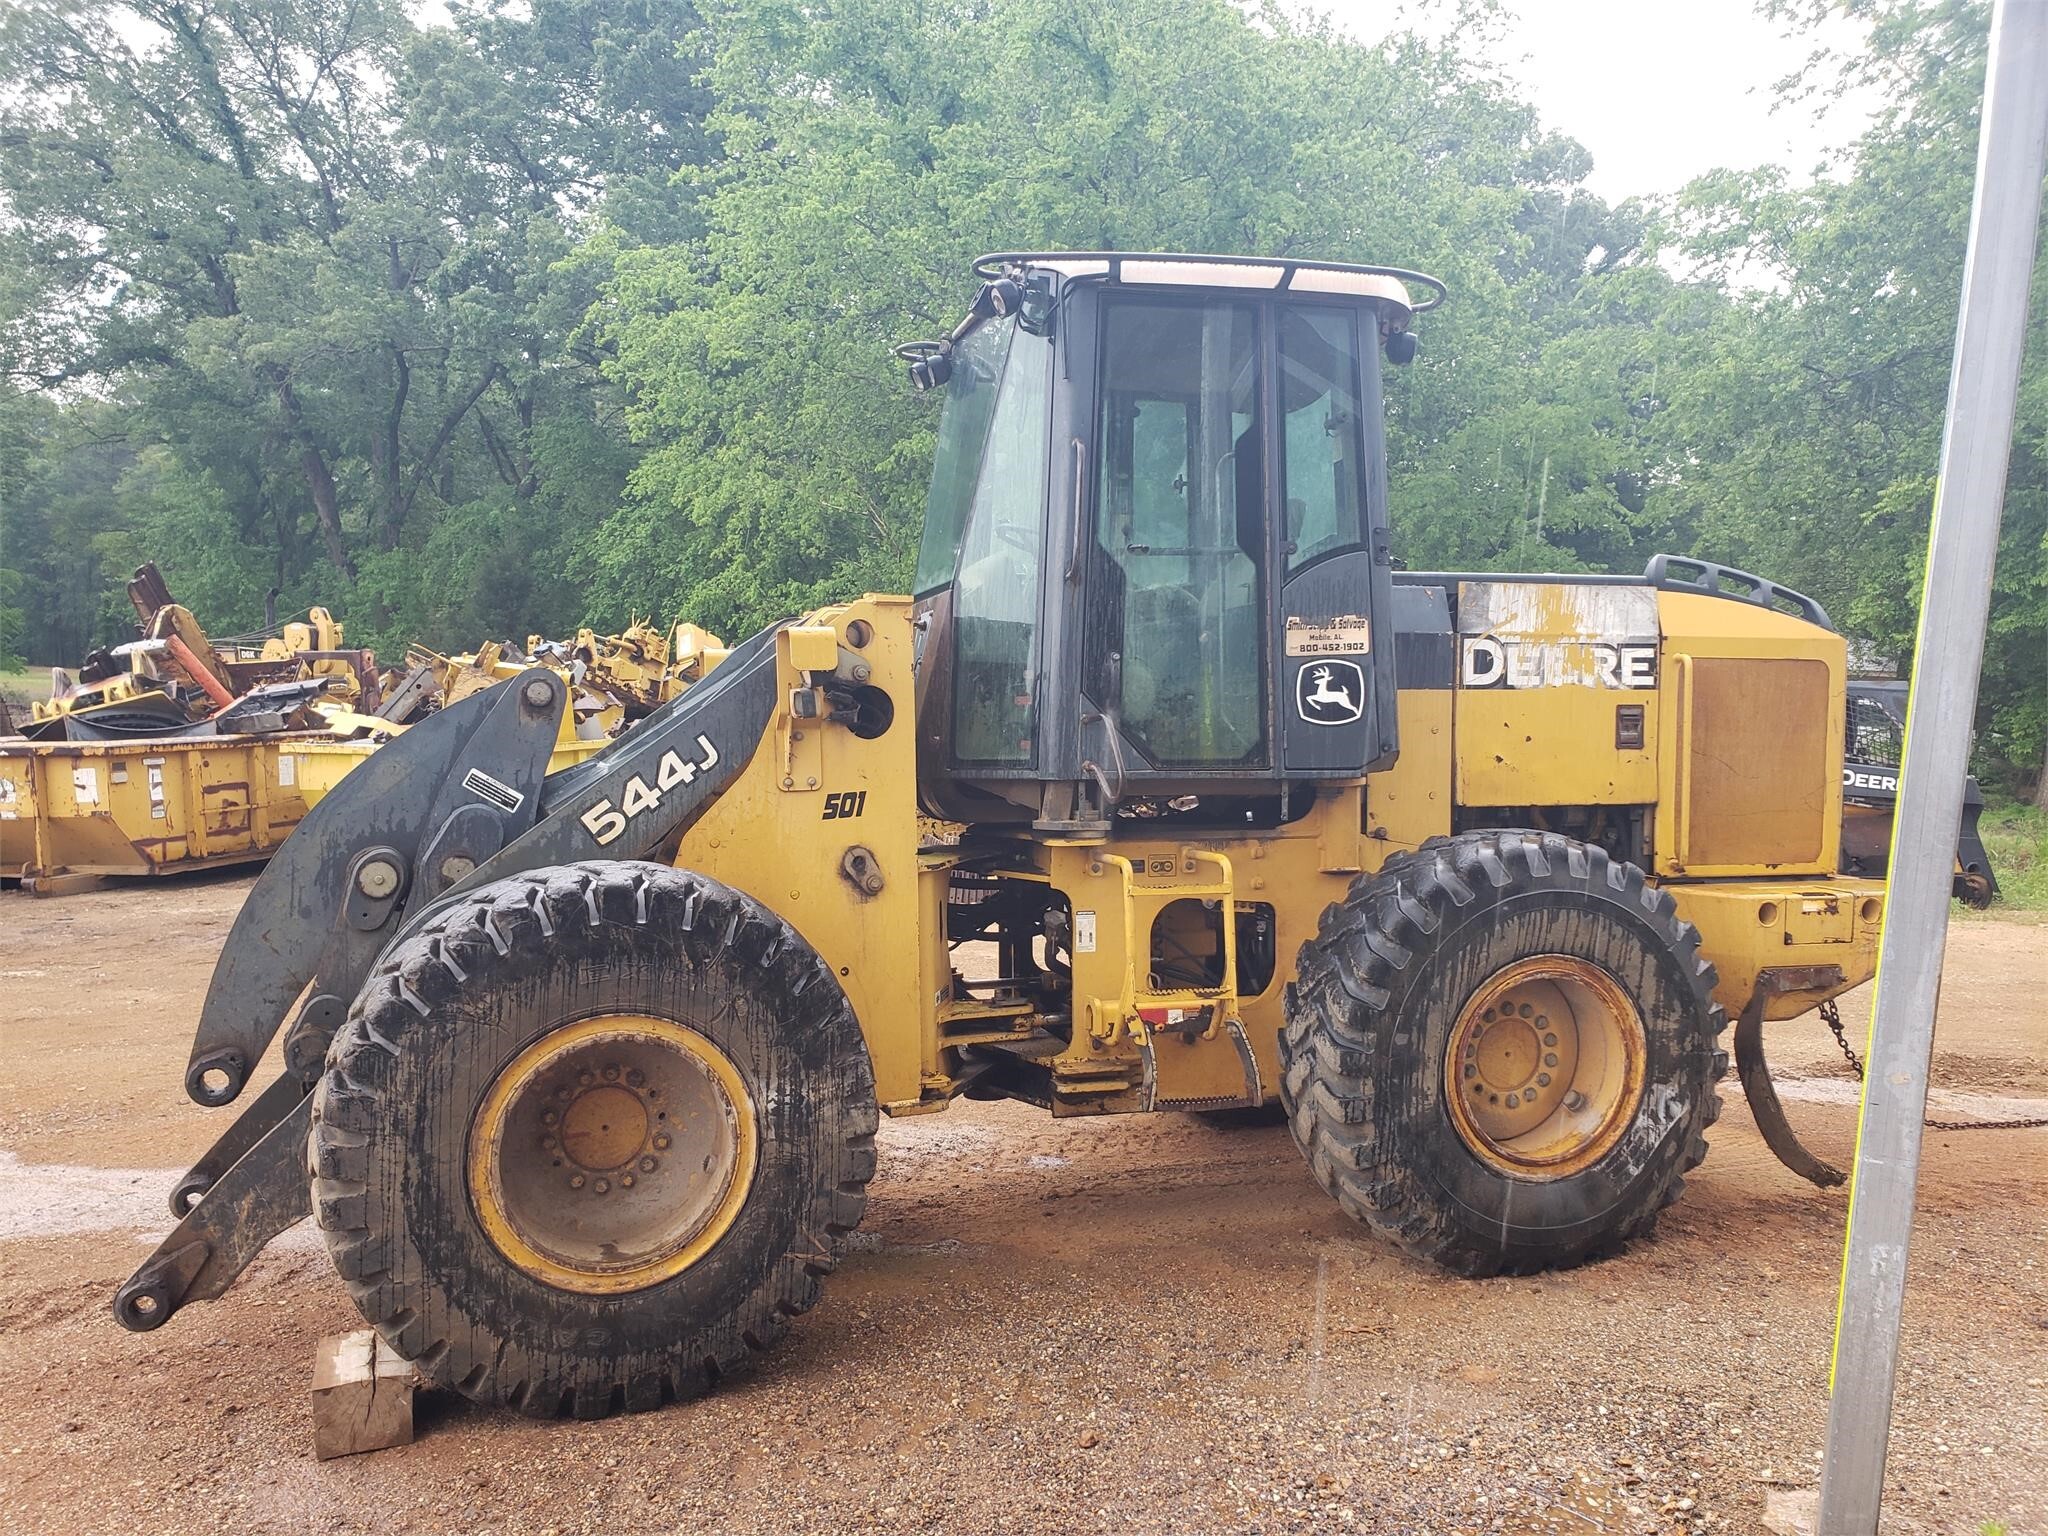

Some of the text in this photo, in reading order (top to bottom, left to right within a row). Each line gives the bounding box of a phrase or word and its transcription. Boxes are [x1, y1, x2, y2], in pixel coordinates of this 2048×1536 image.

[1338, 617, 1366, 631] Salvage
[580, 734, 718, 846] 544J
[822, 791, 867, 820] 501
